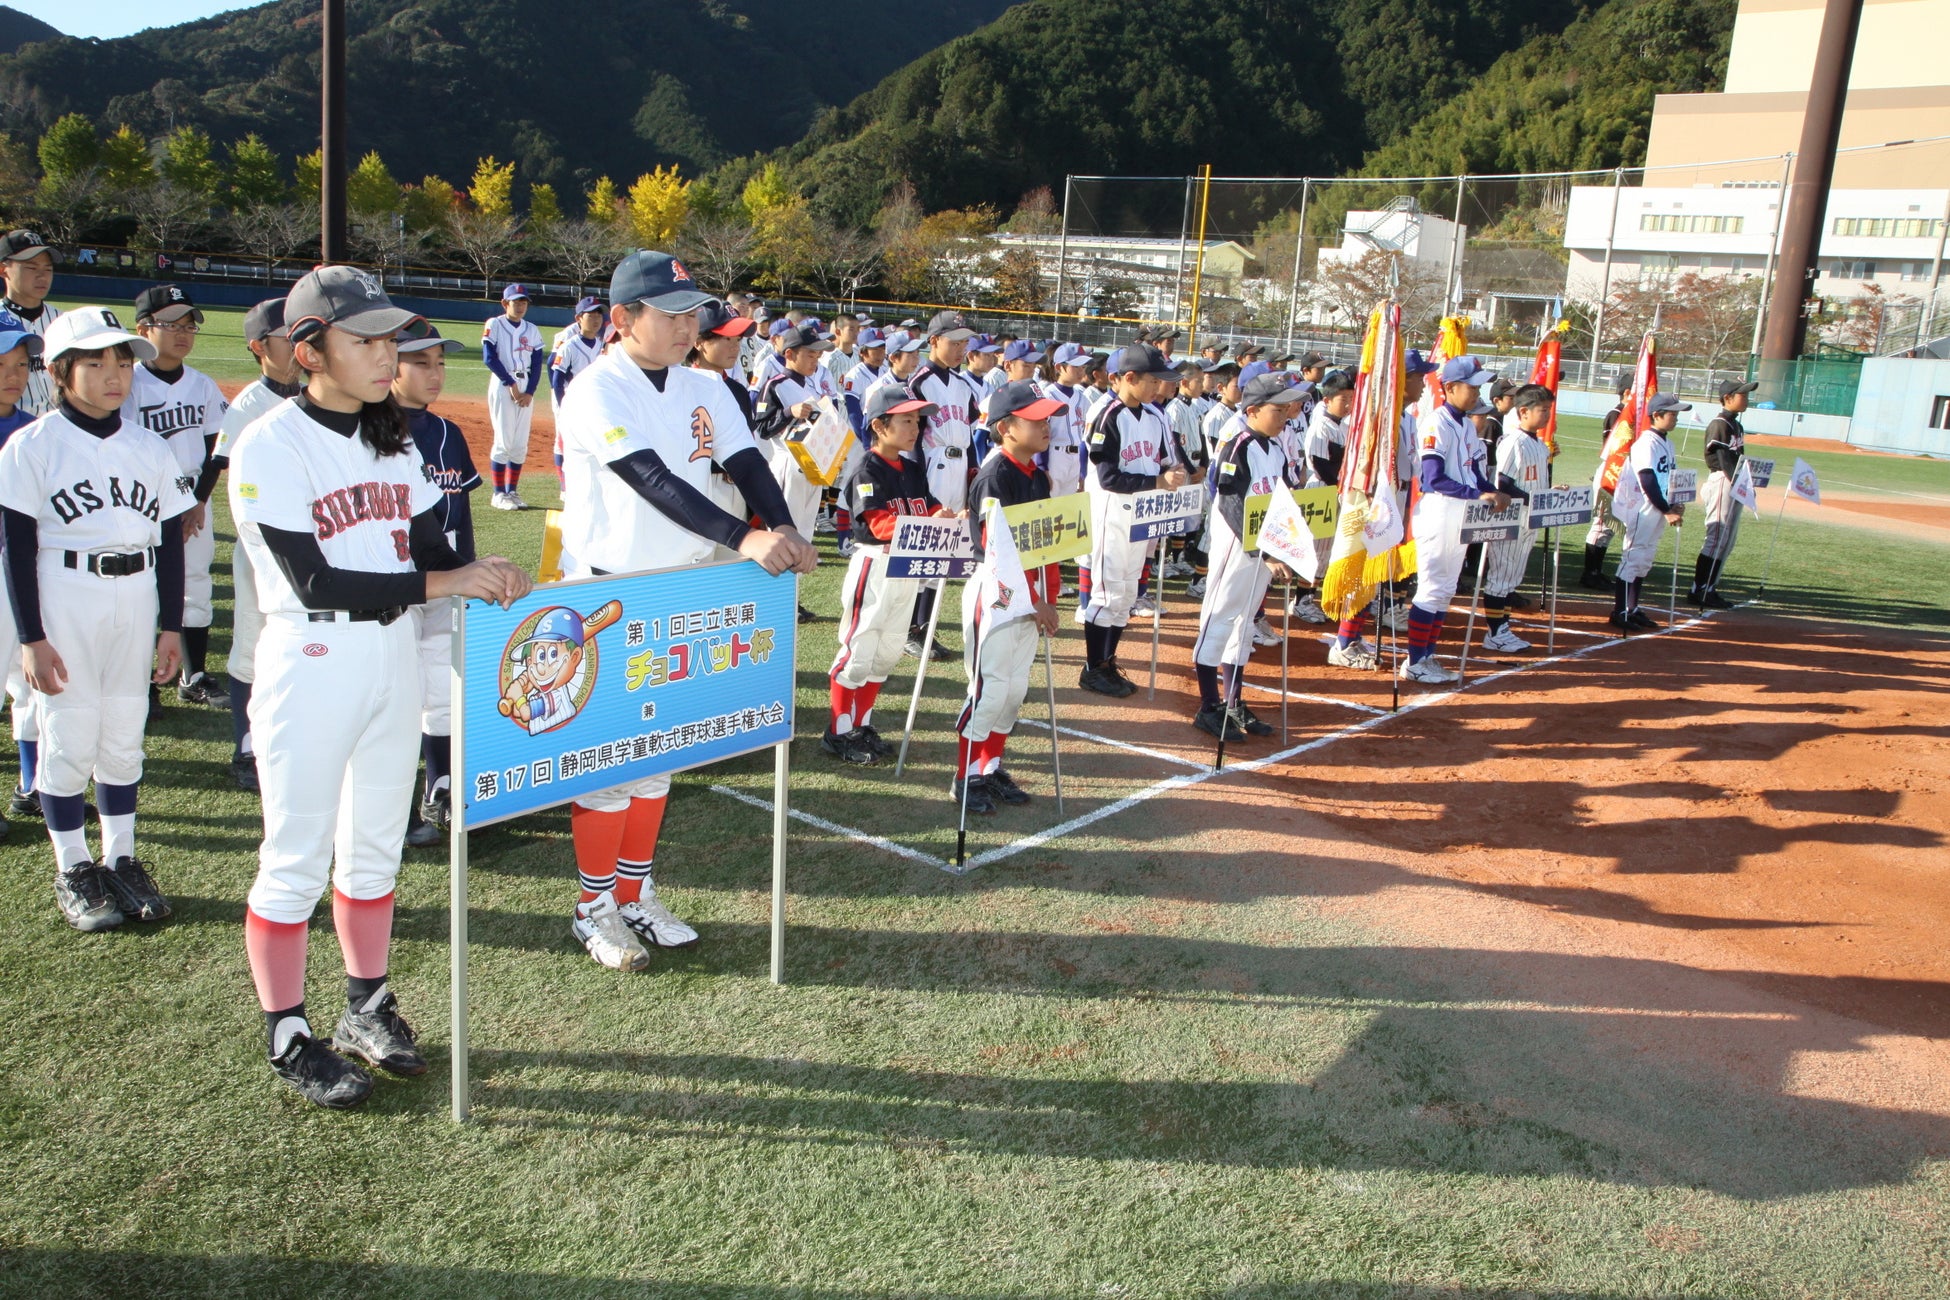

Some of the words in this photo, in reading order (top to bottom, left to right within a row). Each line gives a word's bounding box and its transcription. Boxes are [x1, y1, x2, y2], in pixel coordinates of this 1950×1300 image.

[139, 400, 205, 434] Twins
[689, 405, 715, 464] A
[1524, 464, 1538, 482] 11
[51, 476, 160, 525] OSADA
[897, 523, 976, 553] 細江野球スポー
[1147, 519, 1186, 538] 掛川支部
[908, 559, 950, 576] 浜名湖
[961, 560, 977, 576] 支
[626, 628, 775, 691] チョコバット杯
[643, 704, 655, 719] 兼
